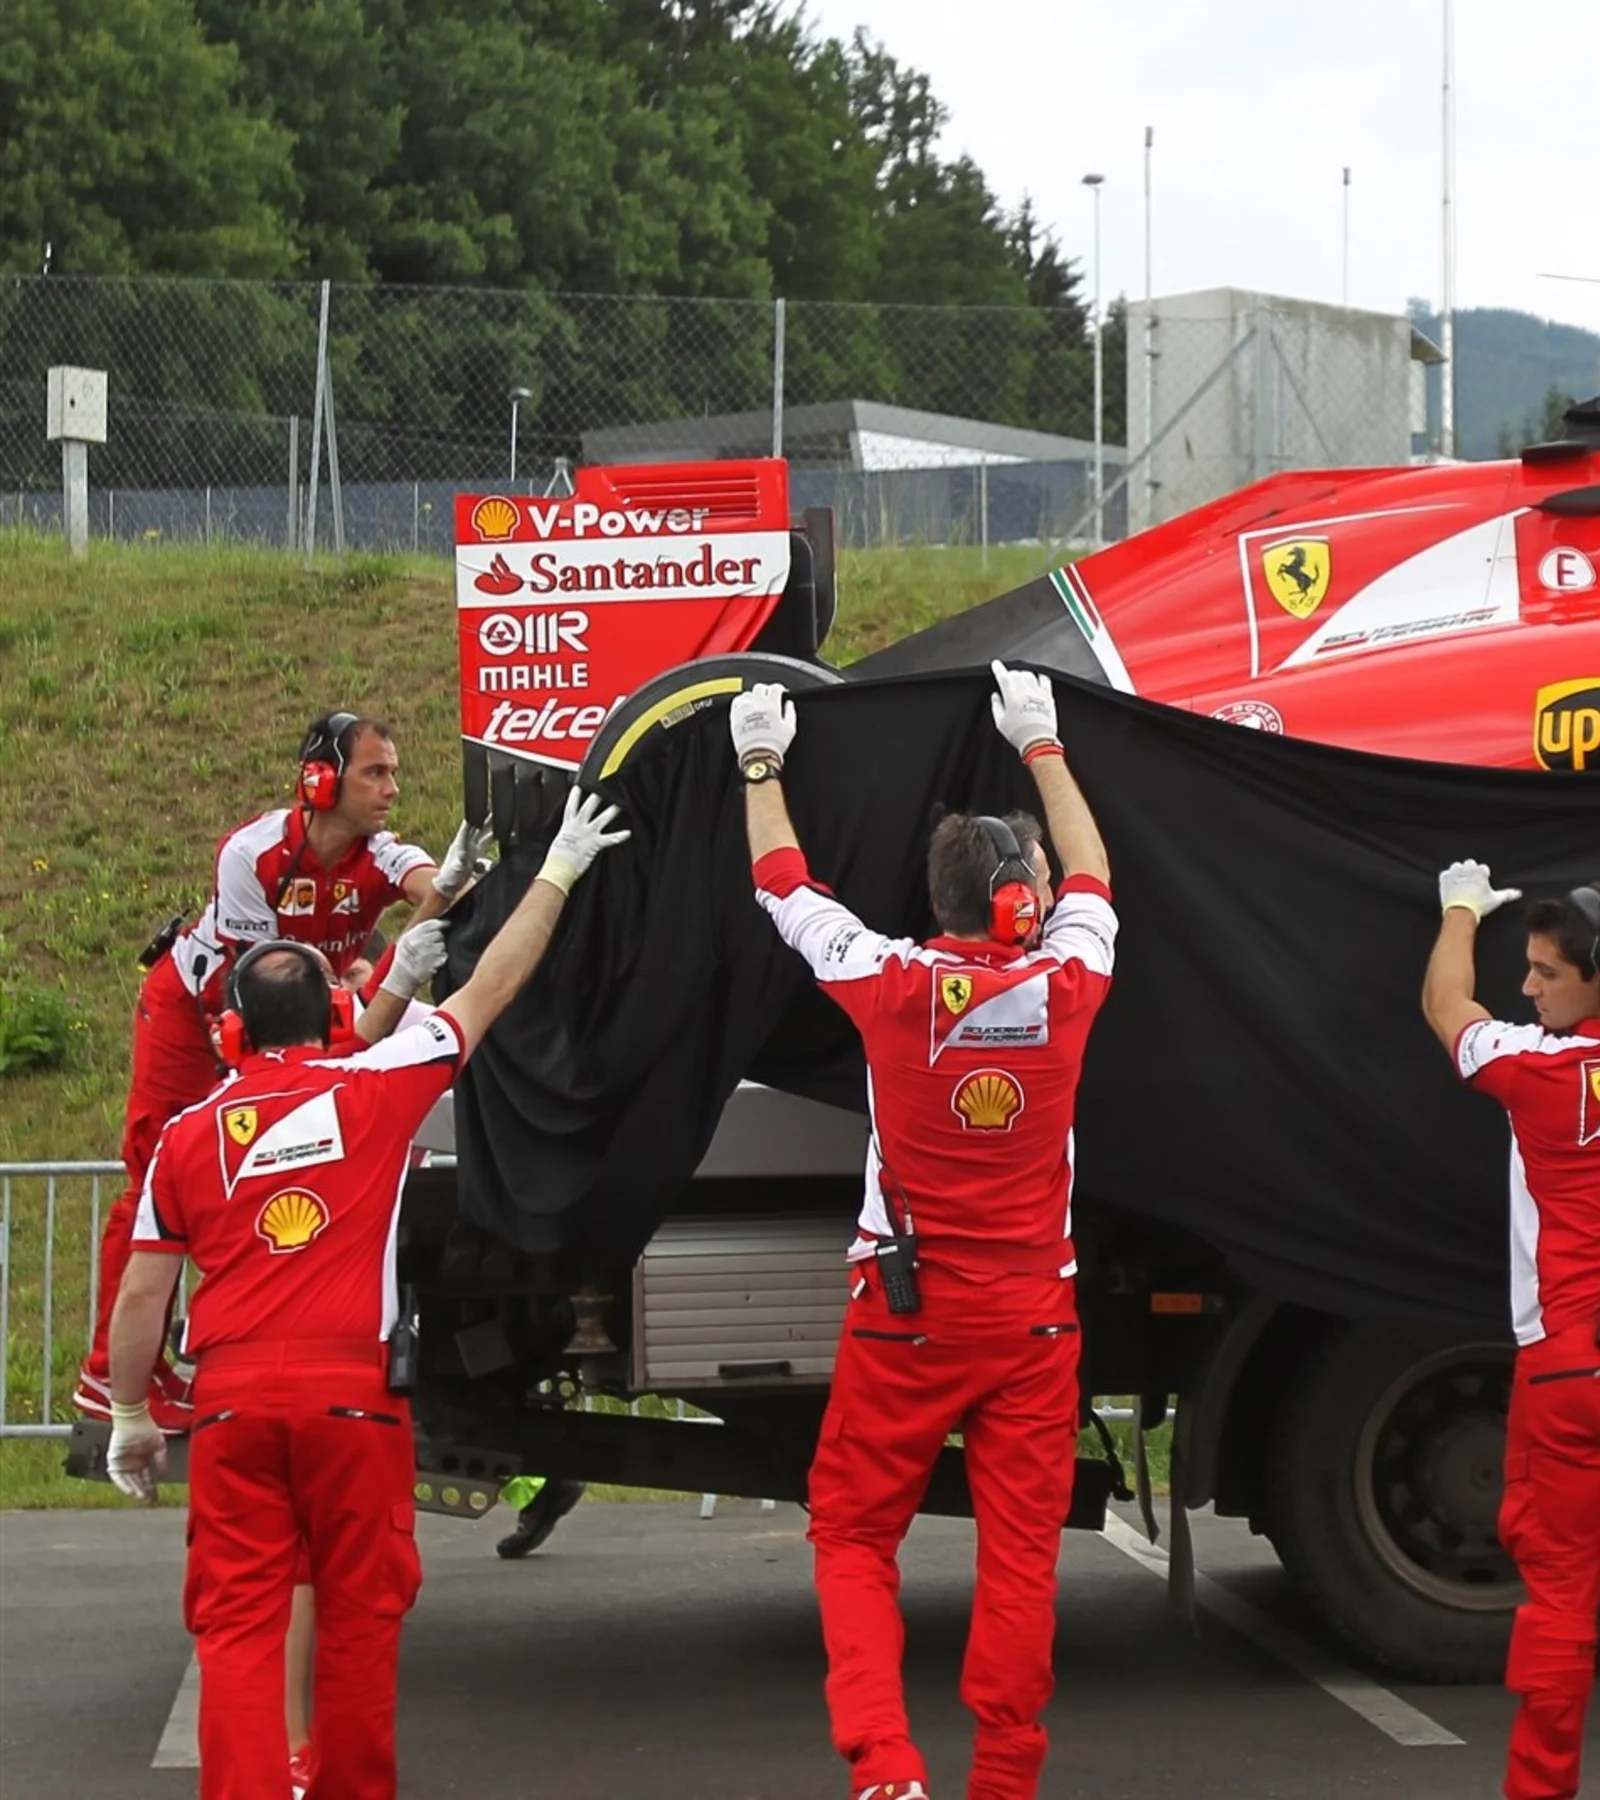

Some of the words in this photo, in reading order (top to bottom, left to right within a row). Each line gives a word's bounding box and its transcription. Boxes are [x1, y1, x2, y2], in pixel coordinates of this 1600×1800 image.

[528, 503, 709, 538] V-Power
[530, 544, 761, 593] Santander
[479, 663, 588, 693] MAHLE
